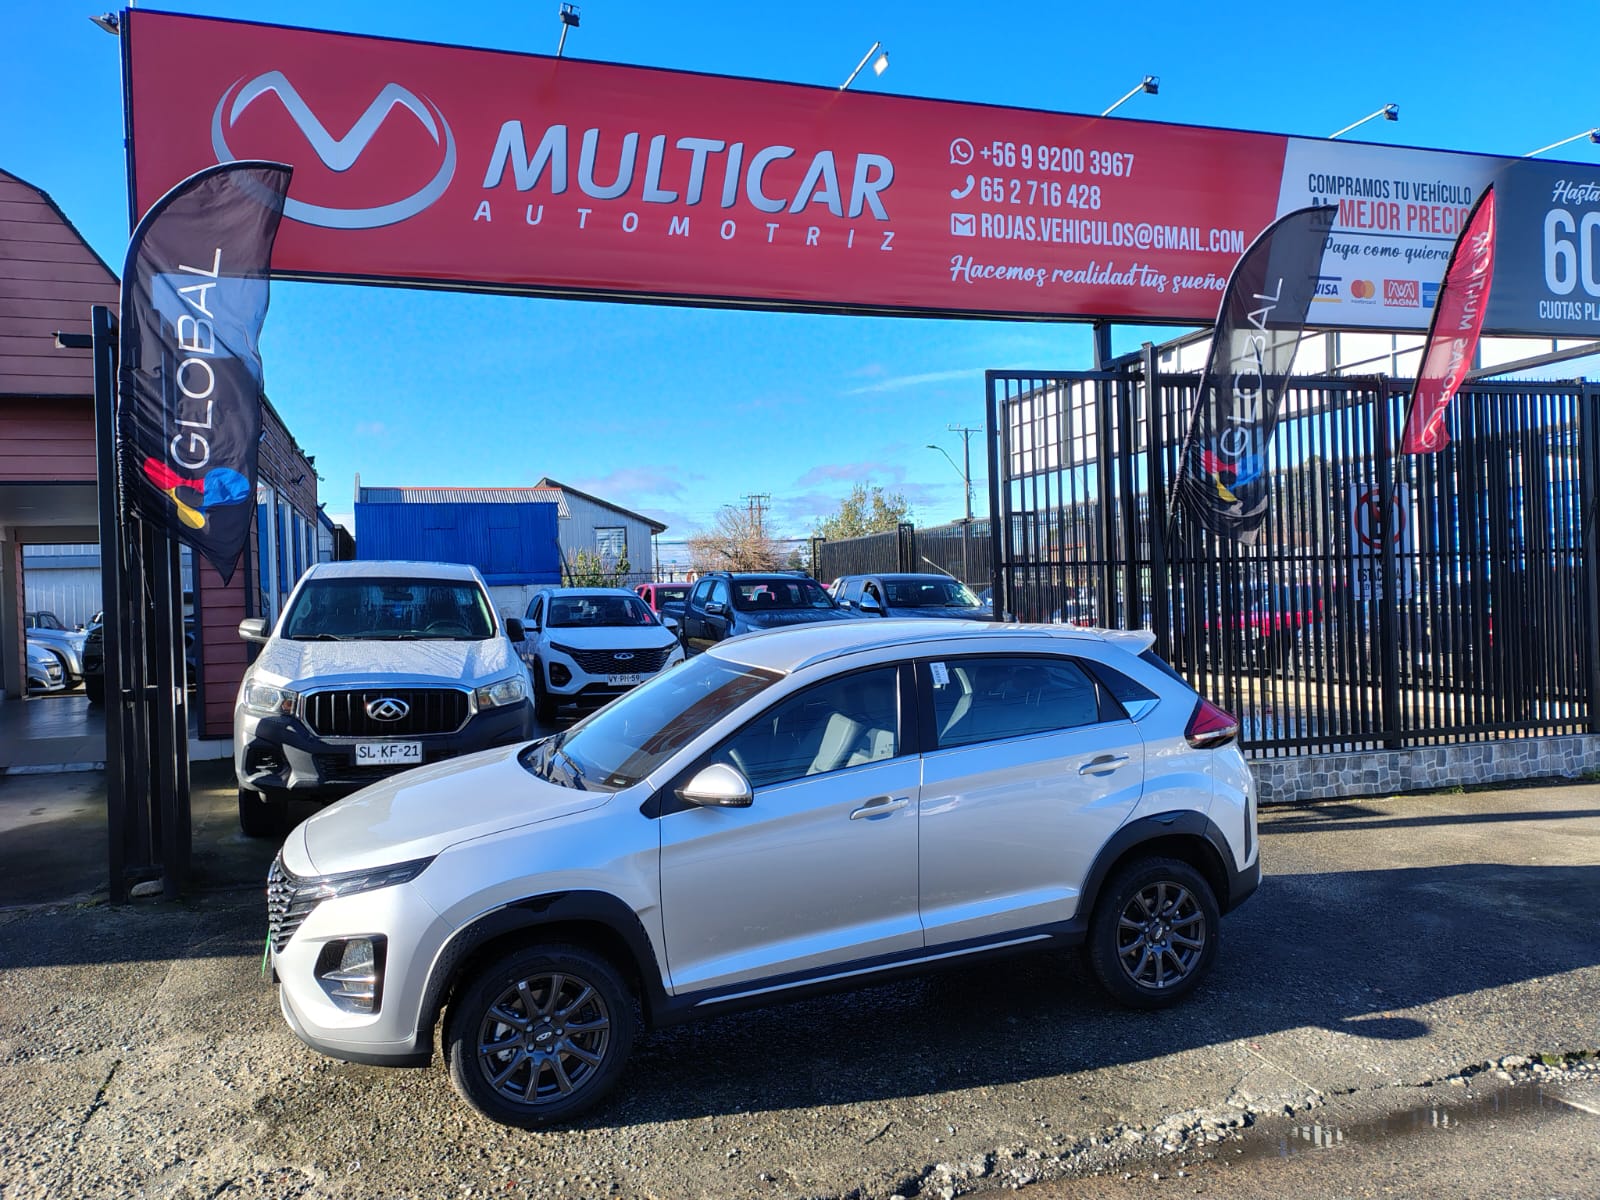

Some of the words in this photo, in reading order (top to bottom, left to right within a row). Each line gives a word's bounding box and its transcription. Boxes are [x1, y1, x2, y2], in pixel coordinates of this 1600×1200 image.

[482, 119, 895, 221] MULTICAR
[980, 141, 1015, 168] +56
[1021, 144, 1033, 169] 9
[1038, 146, 1085, 174] 9200
[1089, 150, 1135, 177] 3967
[980, 176, 1004, 202] 65
[1010, 179, 1021, 204] 2
[1026, 181, 1062, 207] 716
[1066, 184, 1101, 210] 428
[1308, 173, 1390, 199] COMPRAMOS
[1393, 180, 1410, 200] TU
[1412, 180, 1472, 205] VEHÍCULO
[1552, 179, 1600, 205] Hasta
[473, 200, 896, 251] AUTOMOTRIZ
[981, 213, 1245, 253] ROJAS.VEHICULOS@GMAIL.COM
[1339, 199, 1401, 231] MEJOR
[1406, 204, 1470, 235] PRECIO
[1324, 236, 1361, 260] Paga
[1363, 245, 1402, 258] como
[1404, 244, 1452, 264] quiera
[1544, 208, 1600, 298] 60
[950, 255, 1048, 287] Hacemos
[1051, 261, 1136, 287] realidad
[1131, 264, 1169, 293] tus
[1172, 273, 1227, 293] sueño
[1314, 283, 1339, 295] VISA
[1384, 298, 1420, 306] MAGNA
[1539, 300, 1582, 320] CUOTAS
[1585, 302, 1600, 321] PL
[170, 247, 222, 470] GLOBAL
[1219, 278, 1284, 456] GLOBAL
